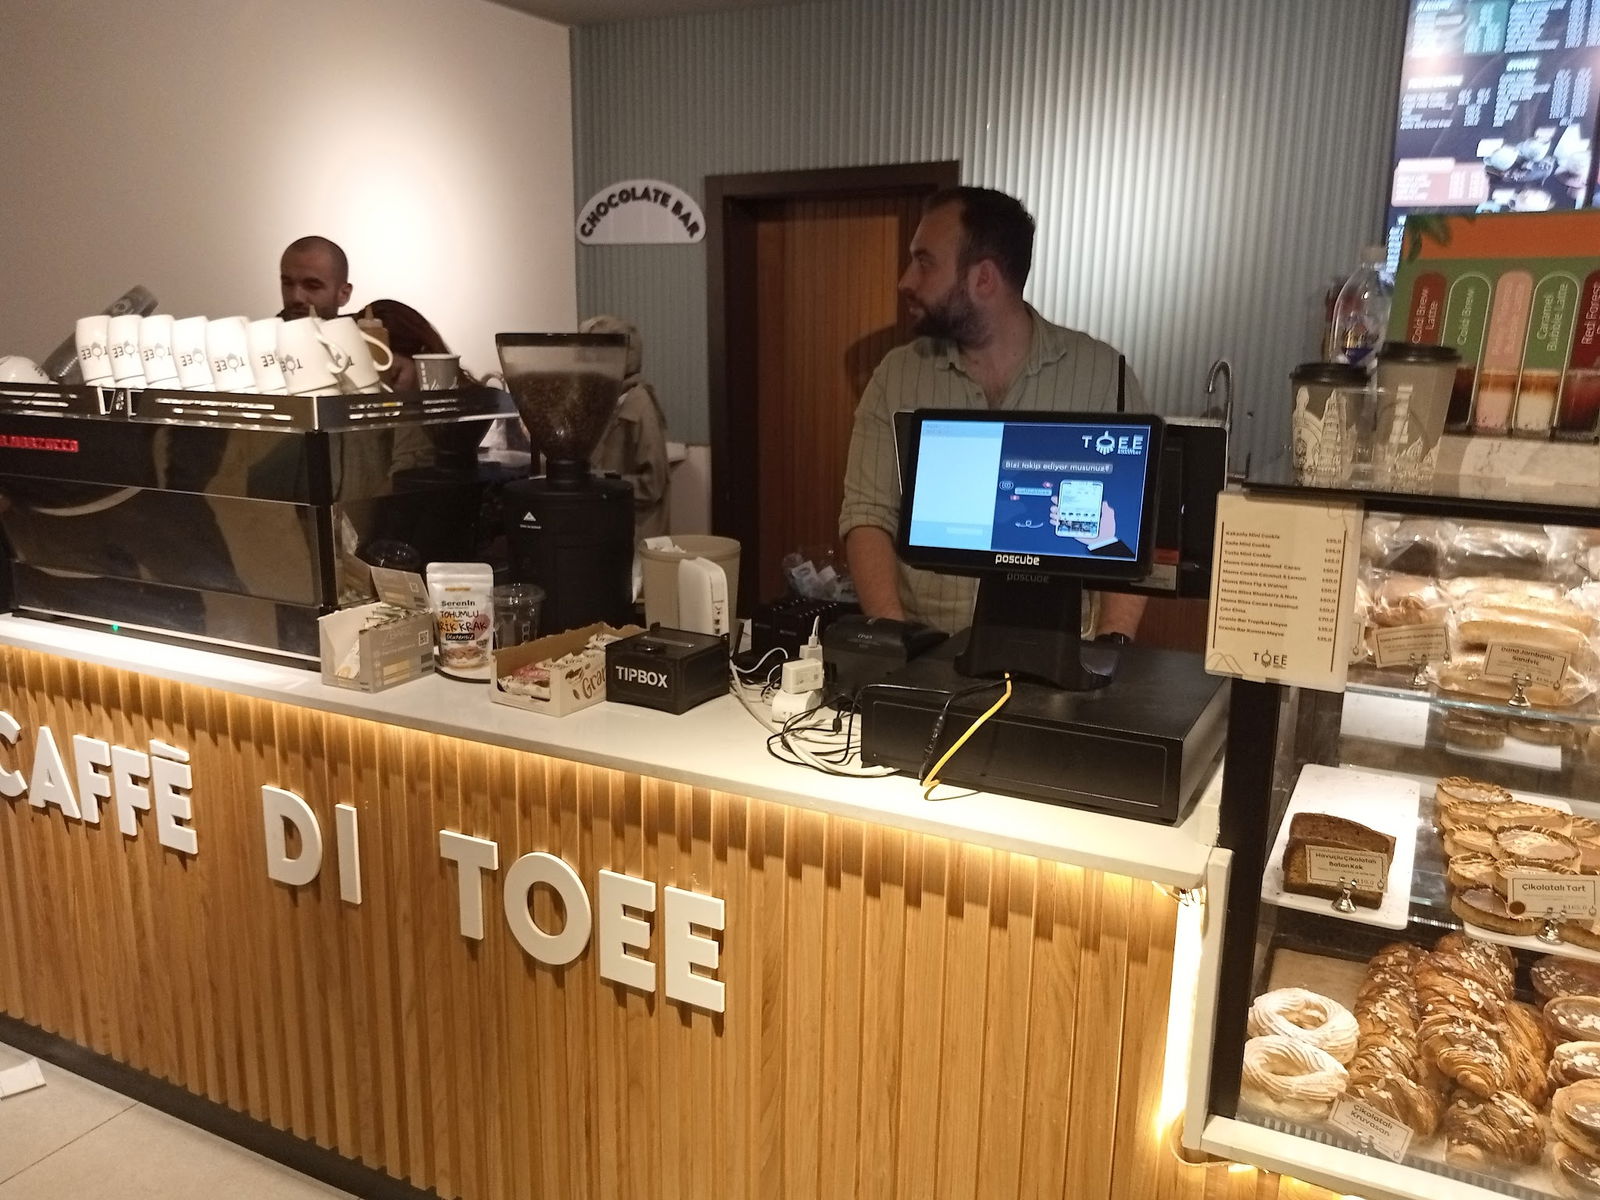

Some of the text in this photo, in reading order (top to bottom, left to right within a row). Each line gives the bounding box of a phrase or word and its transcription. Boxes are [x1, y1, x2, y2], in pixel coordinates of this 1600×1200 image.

[580, 186, 700, 238] CHOCOLATE BAR
[1411, 287, 1429, 344] Cold Brew
[1457, 288, 1475, 346] Cold Brew
[1581, 321, 1596, 344] Red
[1082, 430, 1144, 455] TOEE
[1005, 461, 1021, 469] Bizi
[1043, 463, 1068, 472] ediyor
[995, 554, 1040, 566] poscube
[1253, 591, 1279, 599] Blueberry
[440, 610, 479, 618] TOHUMLU
[438, 620, 487, 632] RİK KRAK
[1253, 650, 1288, 668] TOEE
[616, 666, 668, 688] TIPBOX
[261, 784, 362, 904] DI
[440, 830, 726, 1013] TOEE
[1522, 883, 1565, 892] Çikolatalı
[1350, 1110, 1390, 1136] Kruvasan
[1353, 1104, 1393, 1130] Çikolatalı
